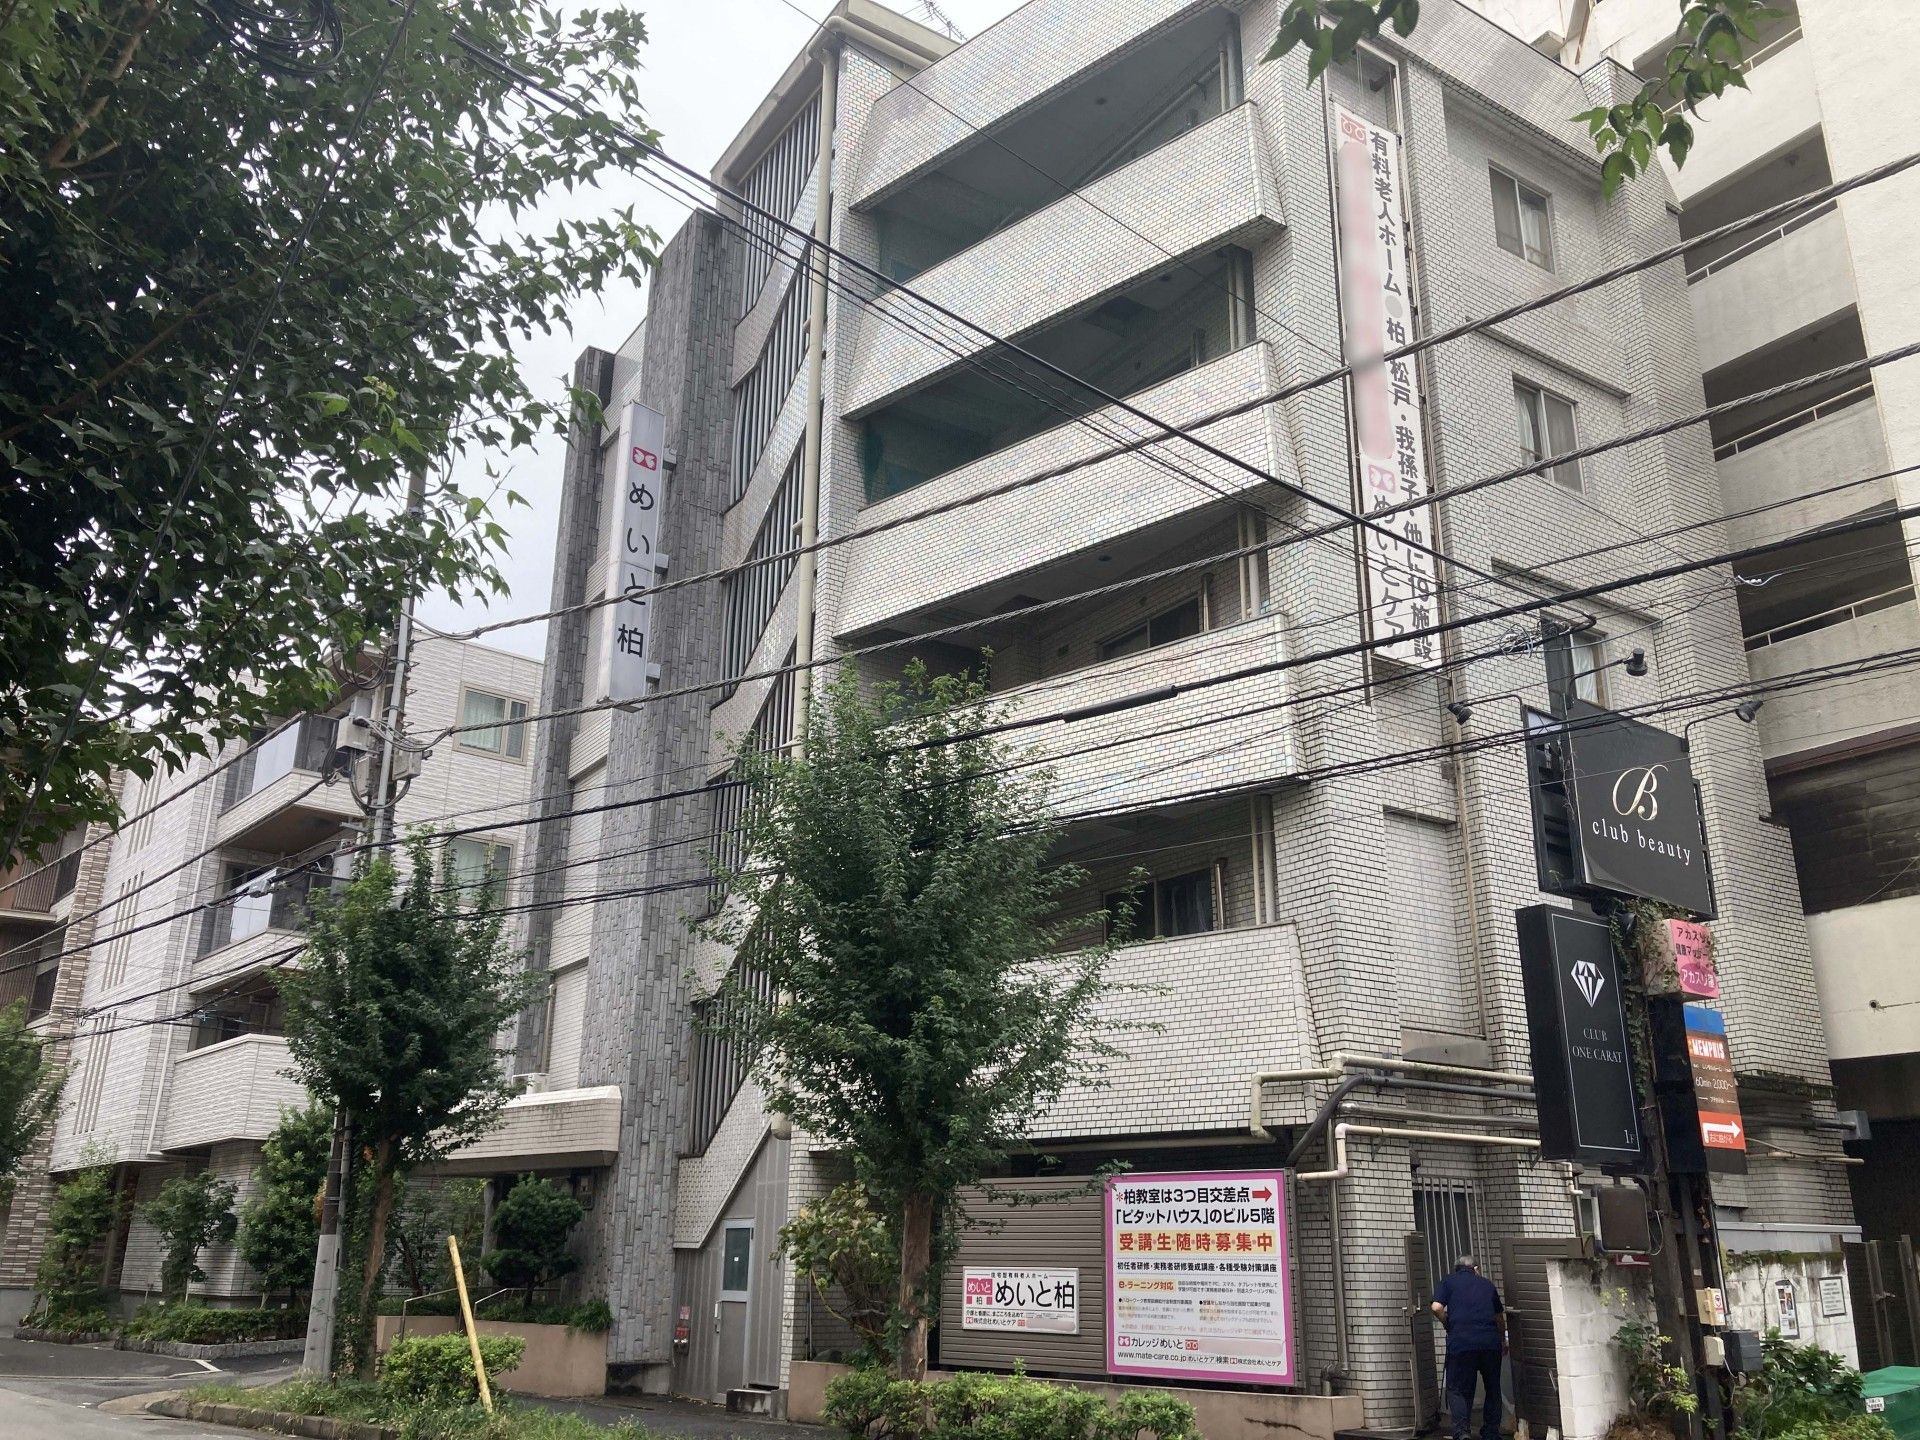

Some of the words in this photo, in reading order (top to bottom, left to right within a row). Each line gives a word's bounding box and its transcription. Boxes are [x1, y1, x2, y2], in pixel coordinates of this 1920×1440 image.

[1369, 130, 1402, 296] 有料老人ホーム
[617, 482, 655, 658] めいと柏
[1612, 764, 1669, 821] B
[1592, 818, 1629, 843] club
[1636, 829, 1691, 866] beauty
[1583, 1028, 1608, 1042] CLUB
[1572, 1045, 1593, 1060] ONE
[1593, 1048, 1623, 1063] CARAT
[1692, 1039, 1725, 1060] MEMPHIS
[1116, 1207, 1275, 1225] 「ピタットハウス」のビル5階
[967, 1282, 992, 1294] めいと
[995, 1280, 1075, 1309] めいと柏
[976, 1296, 983, 1305] 柏
[1131, 1338, 1184, 1350] カレッジめいと
[1117, 1351, 1187, 1363] www.mate-care.co.jp
[1187, 1355, 1215, 1364] めいとケア
[1216, 1355, 1229, 1365] 検索
